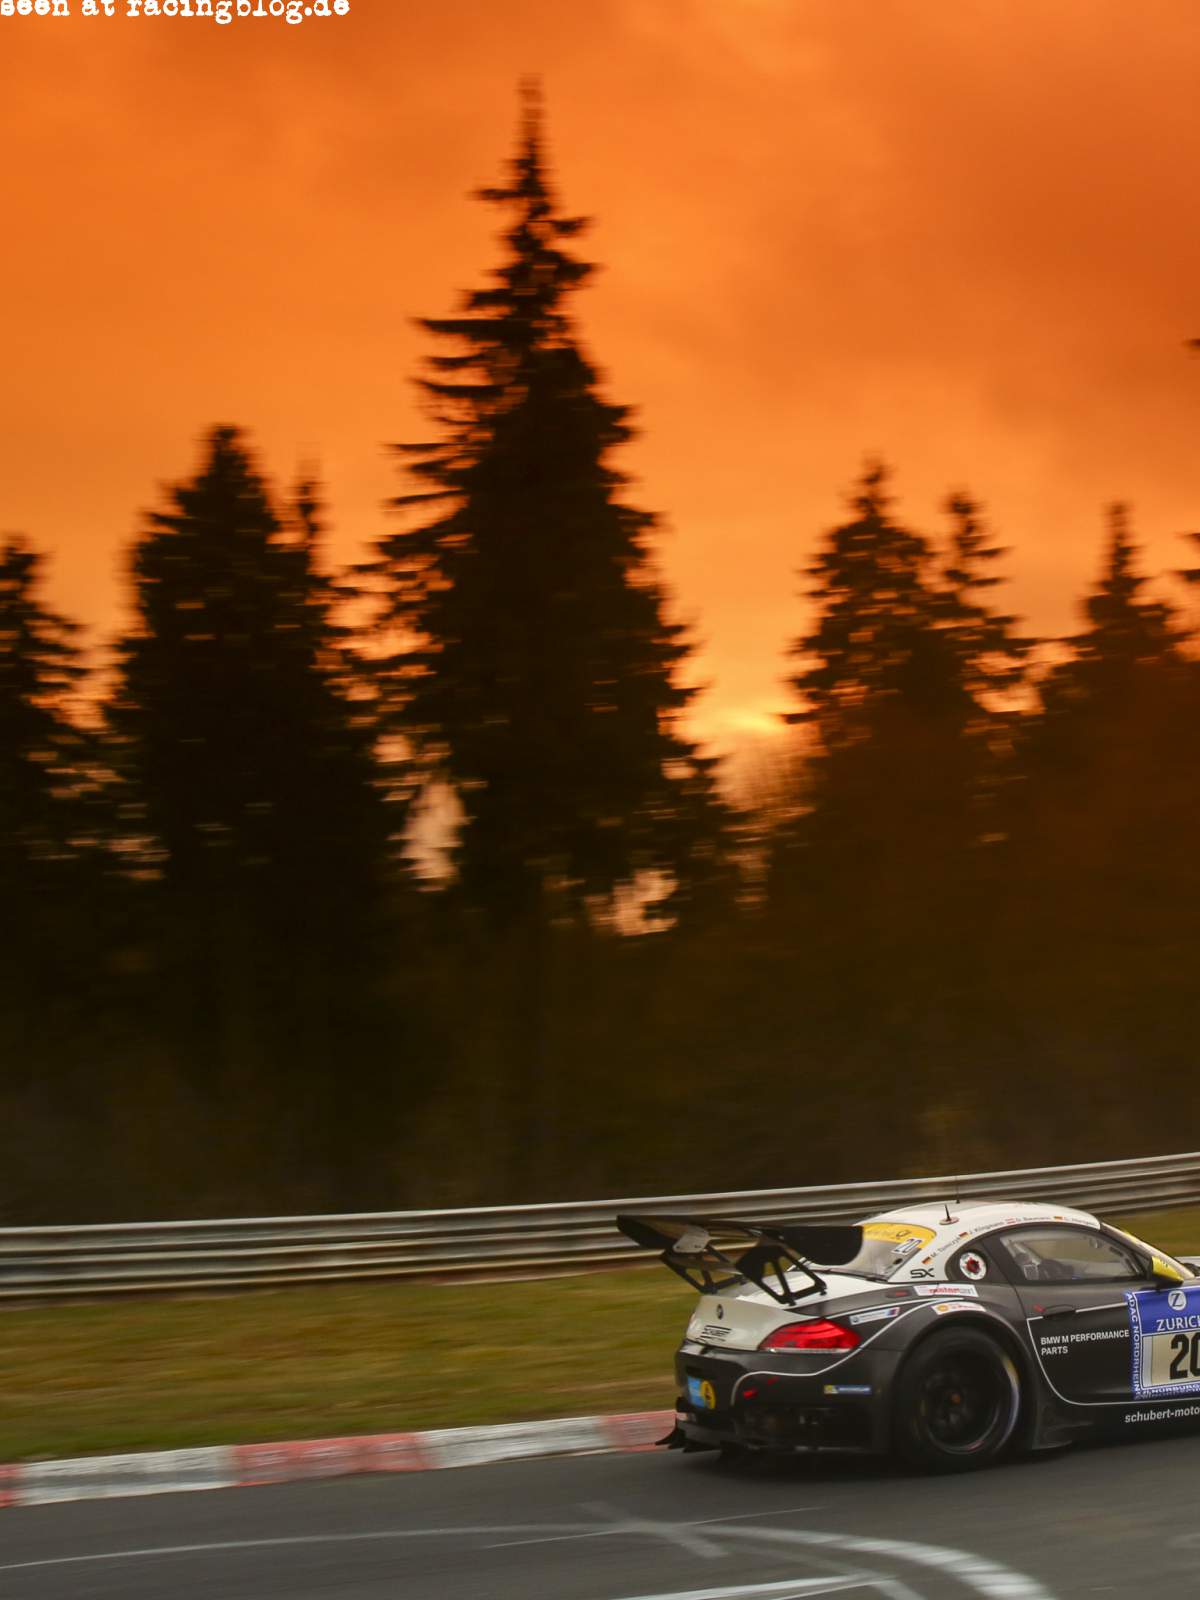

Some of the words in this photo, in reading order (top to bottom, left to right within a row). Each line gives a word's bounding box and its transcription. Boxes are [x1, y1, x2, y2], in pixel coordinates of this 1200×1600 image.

[1125, 1292, 1138, 1322] ADAC
[1041, 1336, 1060, 1345] BMW
[1062, 1335, 1069, 1343] M
[1070, 1329, 1130, 1342] PERFORMANCE
[1041, 1346, 1069, 1356] PARTS
